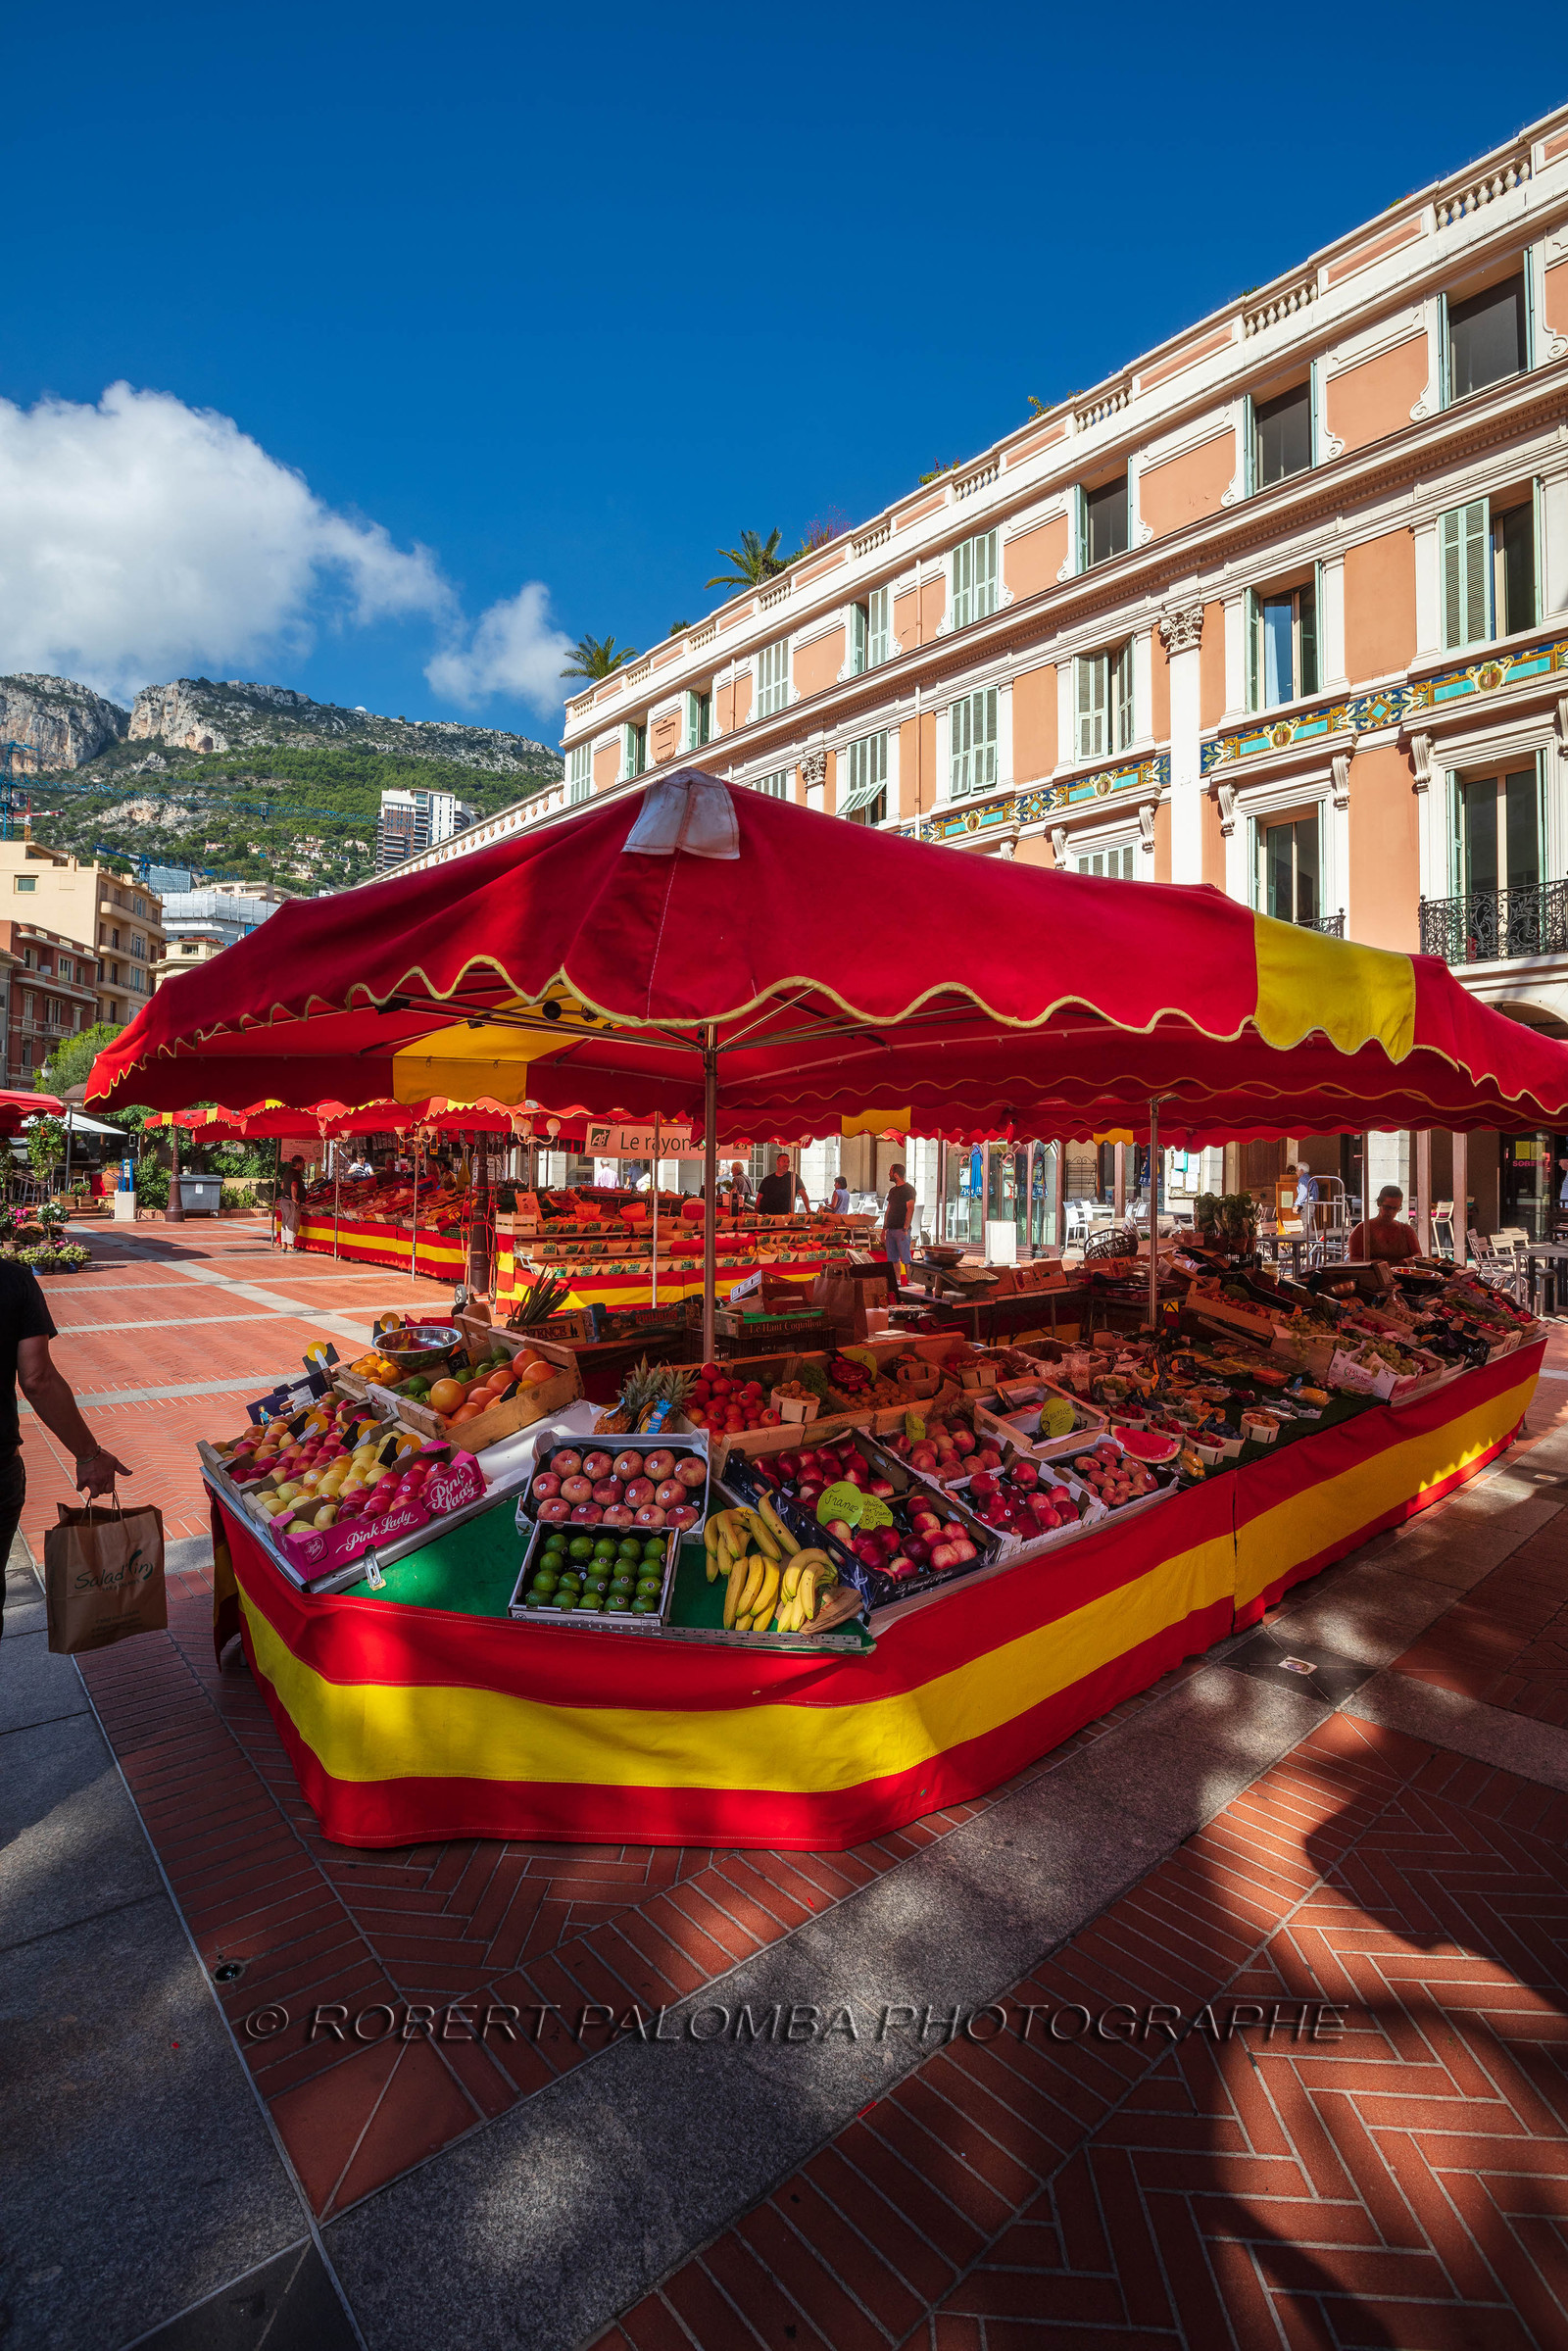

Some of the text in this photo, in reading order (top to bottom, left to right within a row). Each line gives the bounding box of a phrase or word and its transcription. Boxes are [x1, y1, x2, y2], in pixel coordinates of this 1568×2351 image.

[620, 1132, 639, 1151] Le
[645, 1136, 693, 1155] rayon
[750, 1319, 822, 1334] Le Haut Coquillon
[424, 1467, 466, 1509] Pink
[824, 1489, 859, 1514] France
[335, 1510, 418, 1554] Pink Lady
